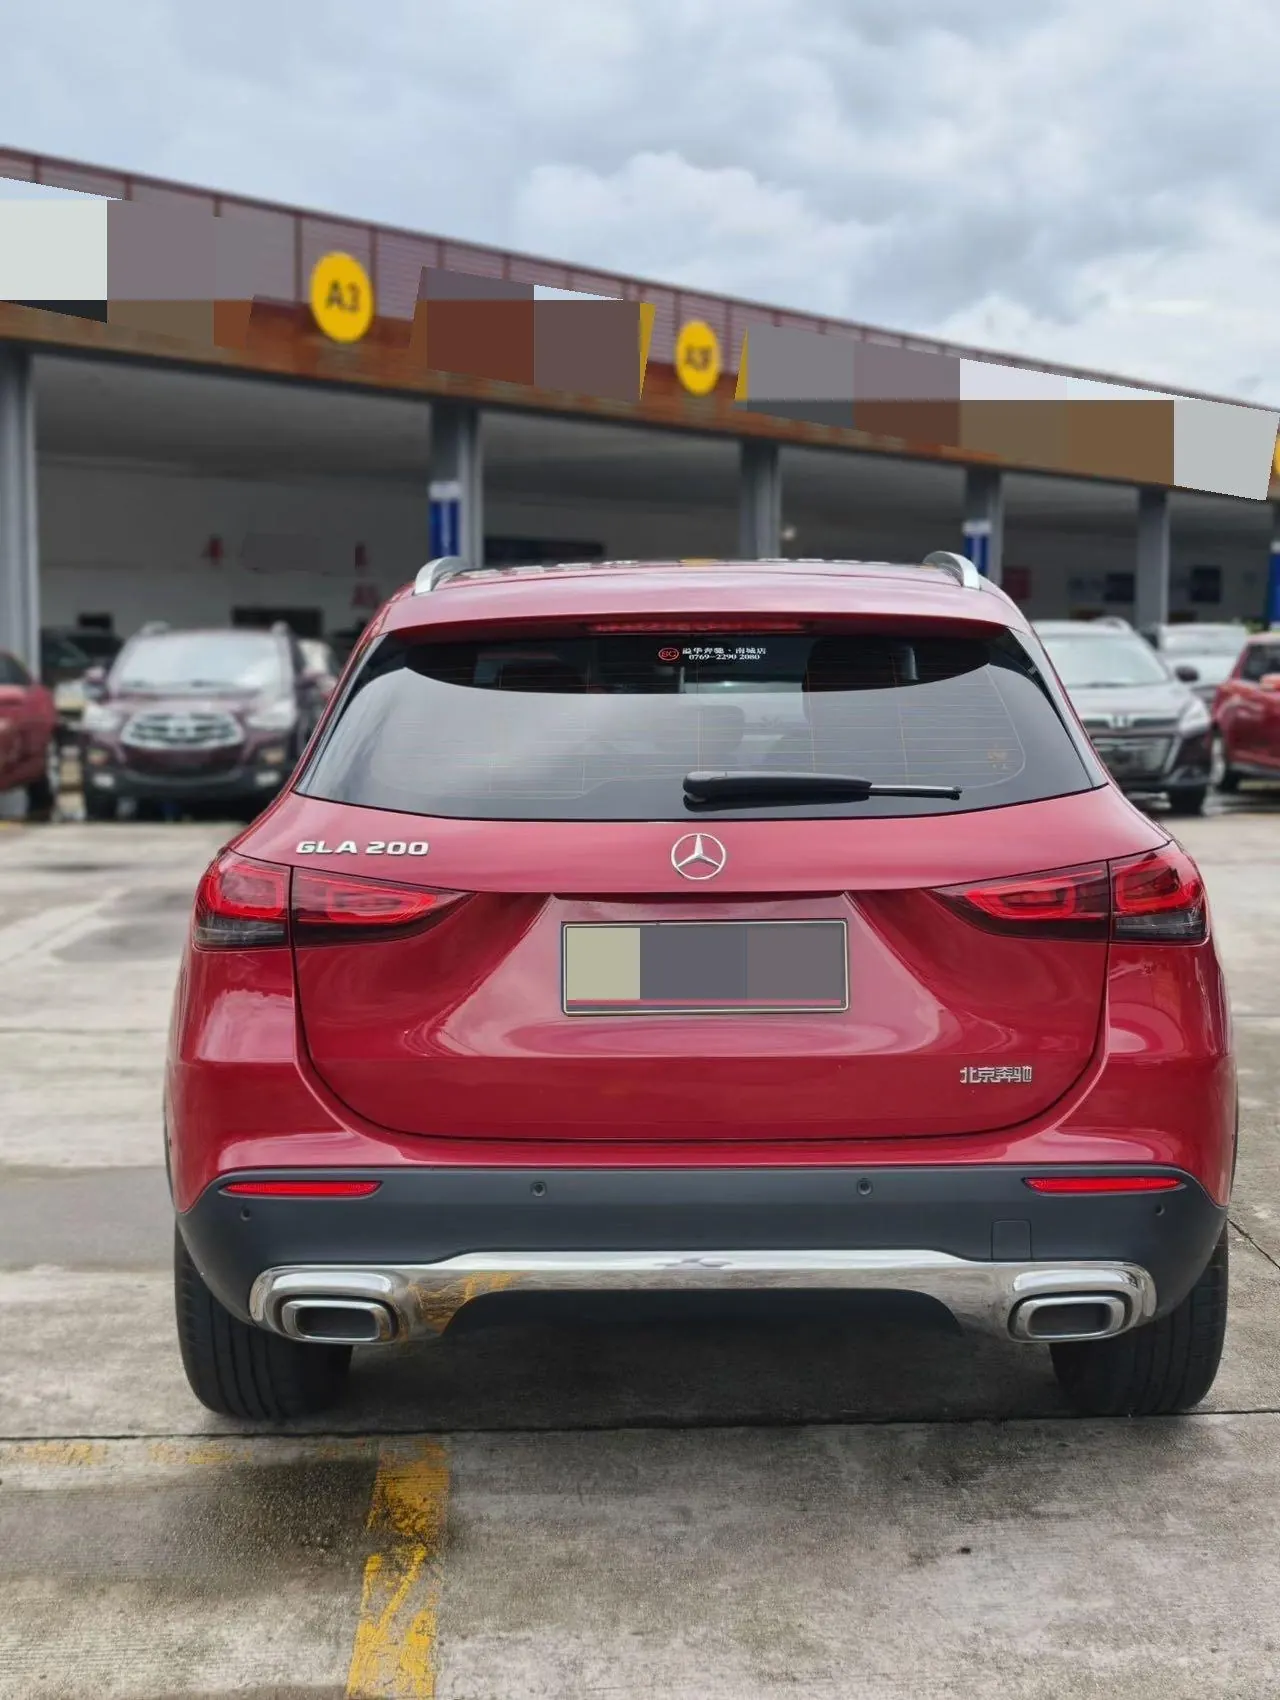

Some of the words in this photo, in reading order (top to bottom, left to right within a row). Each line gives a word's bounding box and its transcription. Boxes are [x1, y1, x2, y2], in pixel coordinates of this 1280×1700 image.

[296, 840, 358, 854] GLA
[365, 840, 429, 856] 200
[960, 1065, 1032, 1084] 北京奔驰
